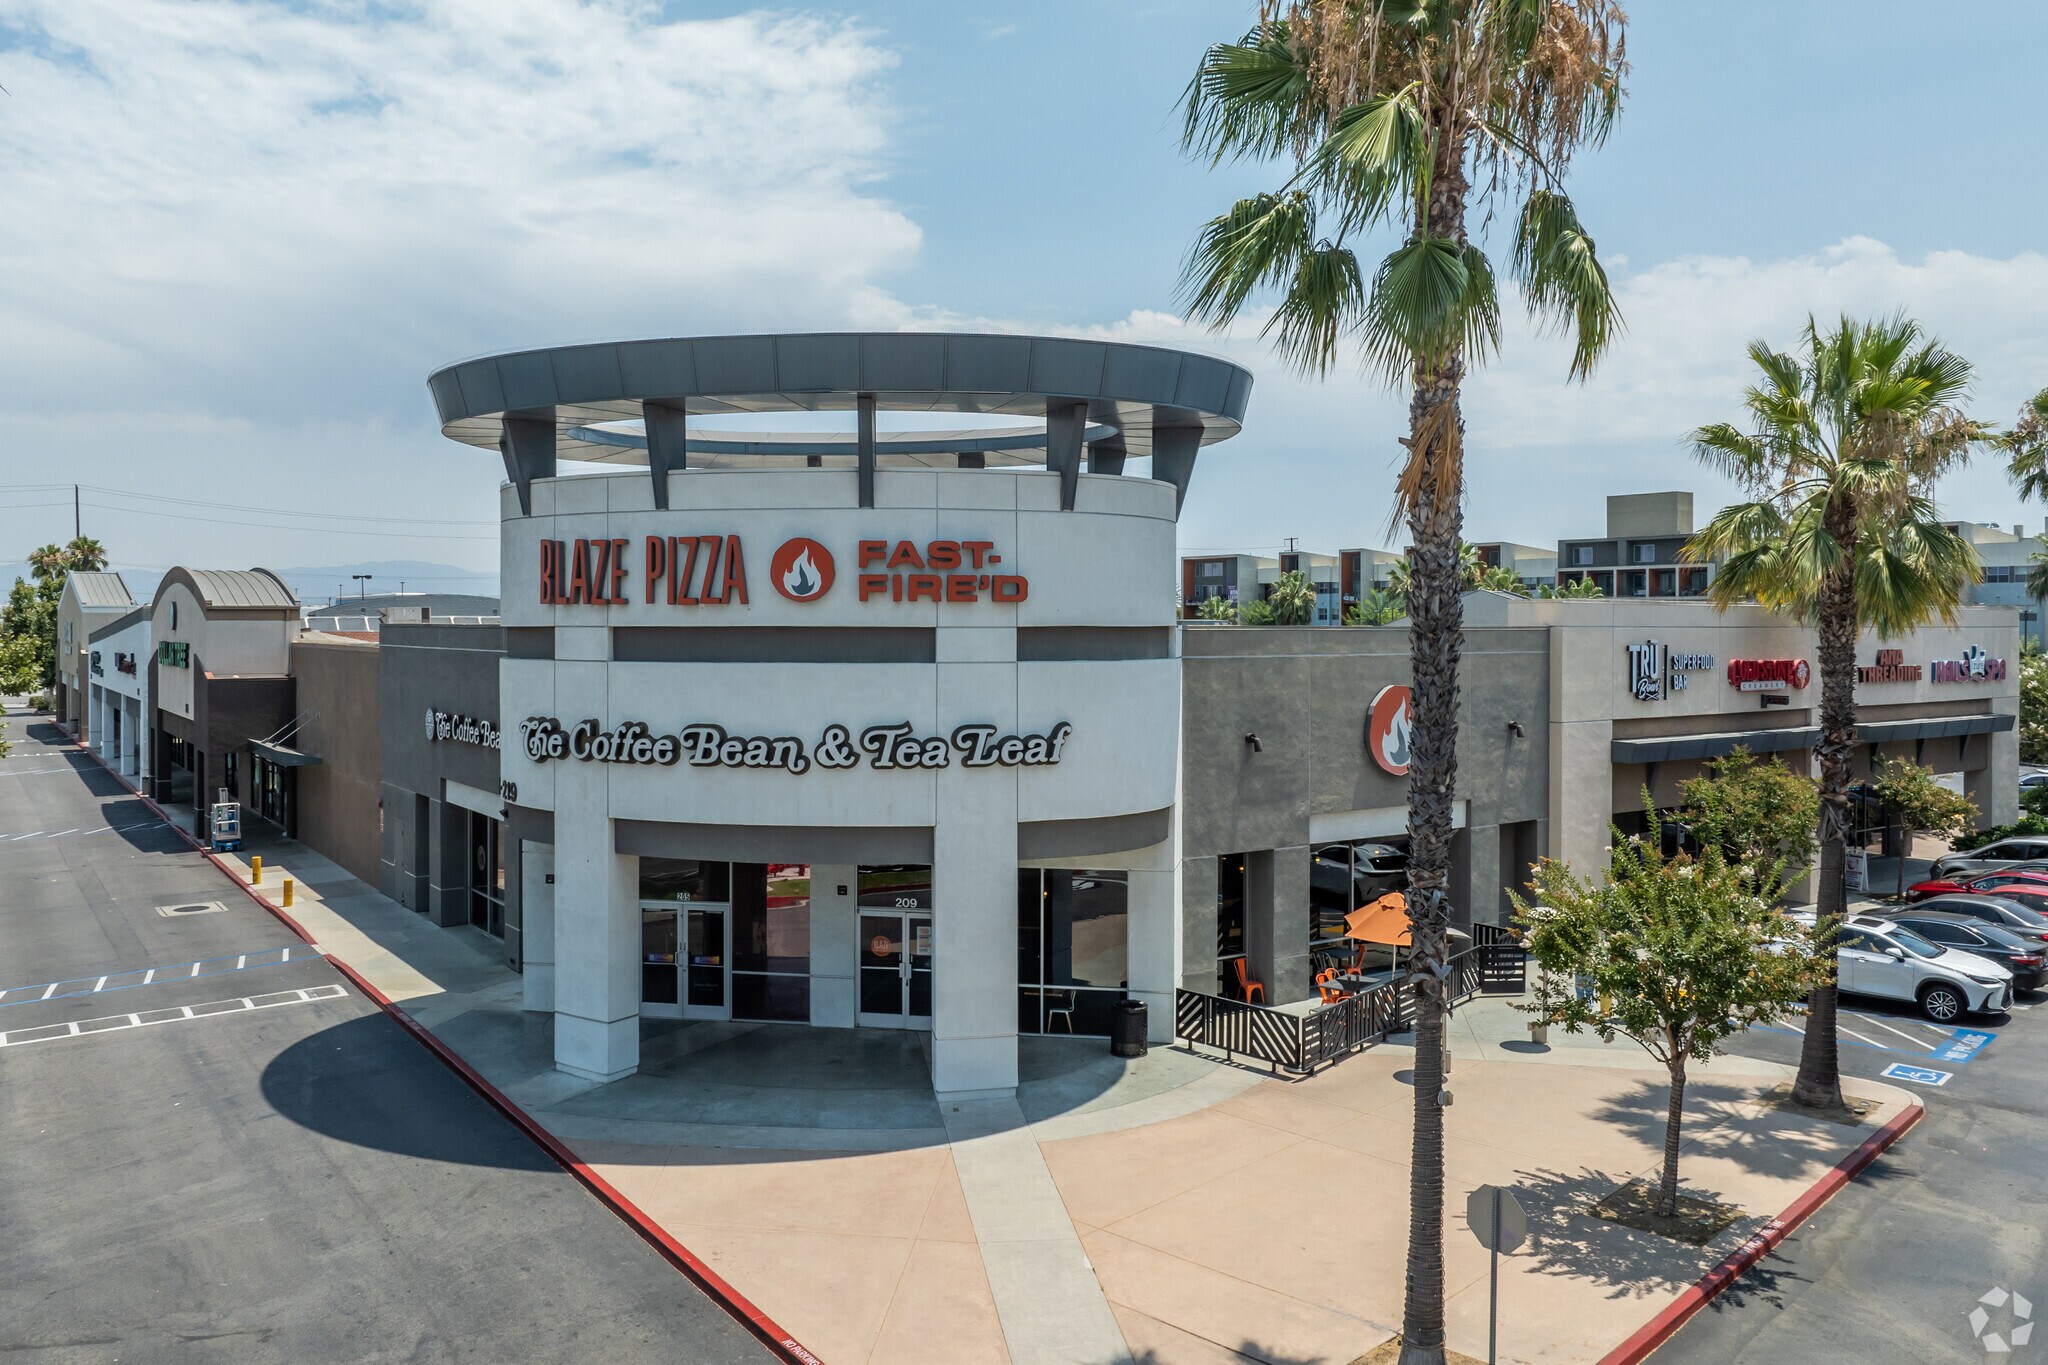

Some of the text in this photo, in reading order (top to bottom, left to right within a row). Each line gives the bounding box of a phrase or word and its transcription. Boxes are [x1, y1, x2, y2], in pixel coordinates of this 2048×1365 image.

[858, 540, 1002, 569] FAST-
[540, 534, 749, 606] BLAZE PIZZA
[858, 574, 1029, 603] FIRE'D
[1673, 655, 1715, 671] SUPERFOOD
[1861, 664, 1922, 683] THREADING
[1935, 658, 2006, 684] NAILS SPA
[1674, 675, 1688, 690] BAR
[435, 712, 501, 750] The Coffee Bea
[519, 717, 1073, 775] The Coffee Bean & Tea Leaf
[895, 897, 918, 908] 209
[782, 1339, 797, 1348] NO
